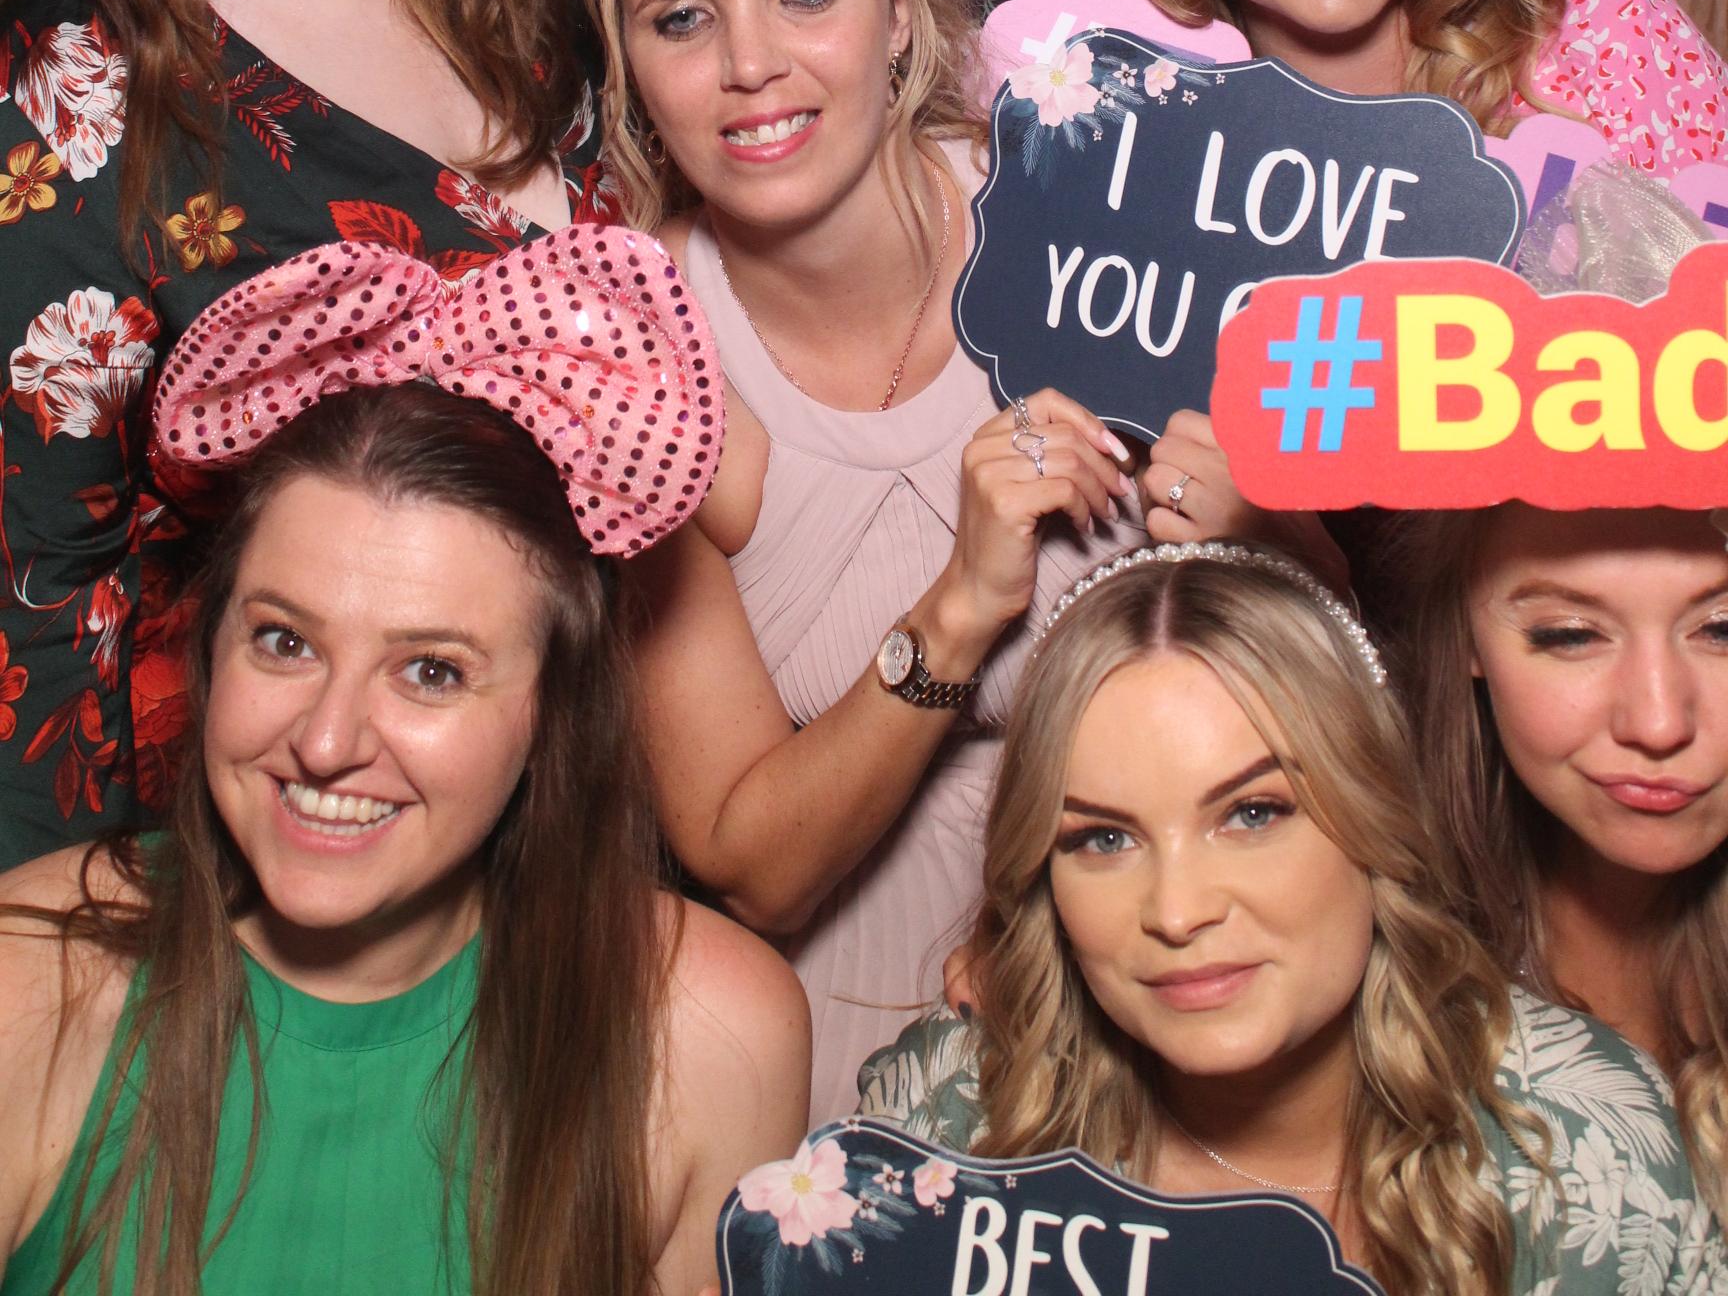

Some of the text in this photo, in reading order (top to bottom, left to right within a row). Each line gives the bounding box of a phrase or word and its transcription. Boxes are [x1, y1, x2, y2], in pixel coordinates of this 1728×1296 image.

[1107, 110, 1137, 211] I
[1194, 130, 1420, 261] LOVE
[1046, 244, 1196, 358] YOU
[951, 1195, 1170, 1296] BEST
